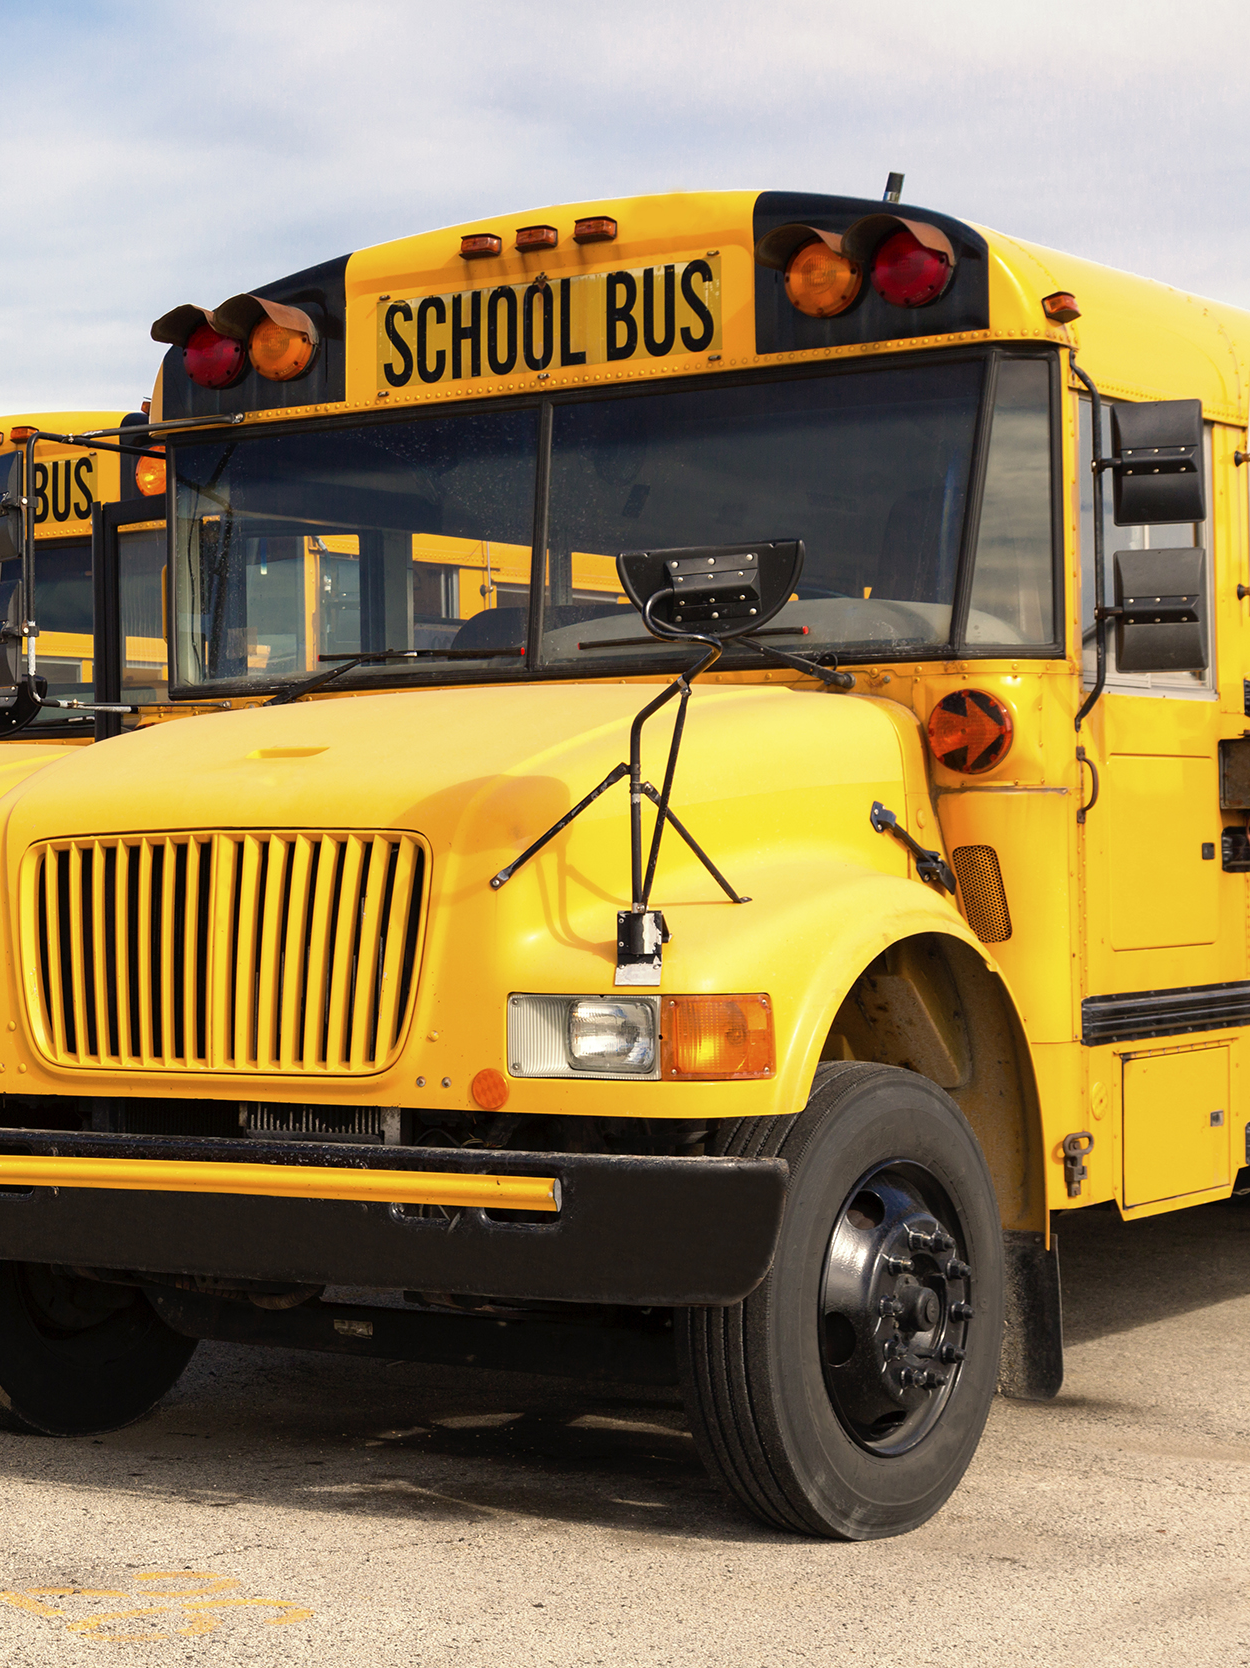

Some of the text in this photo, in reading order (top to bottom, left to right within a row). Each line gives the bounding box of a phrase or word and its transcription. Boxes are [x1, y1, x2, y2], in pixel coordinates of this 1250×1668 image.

[383, 259, 715, 388] SCHOOL BUS
[34, 457, 93, 523] BUS
